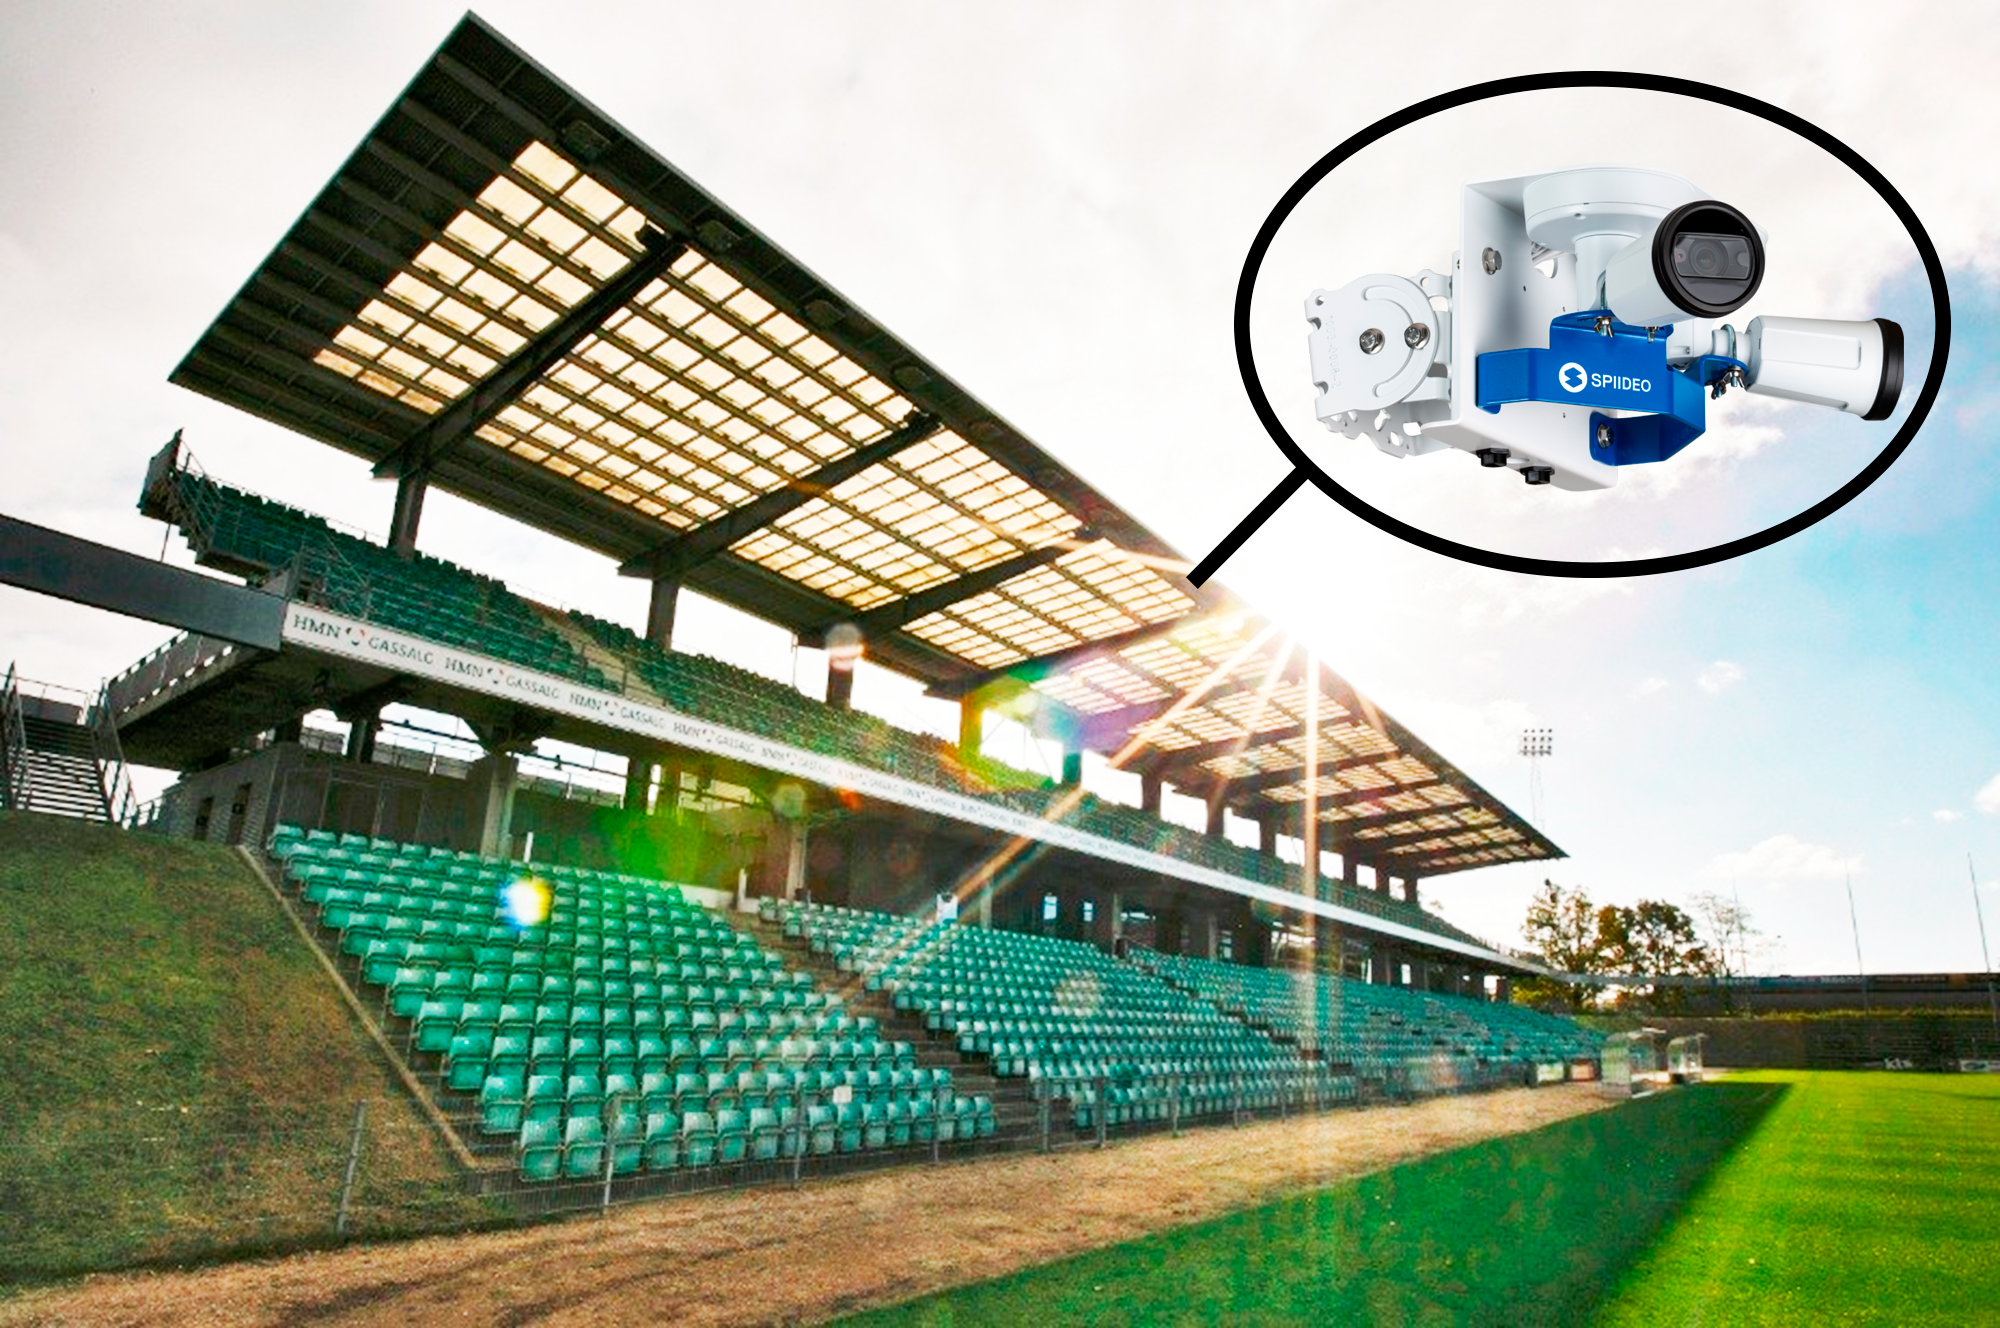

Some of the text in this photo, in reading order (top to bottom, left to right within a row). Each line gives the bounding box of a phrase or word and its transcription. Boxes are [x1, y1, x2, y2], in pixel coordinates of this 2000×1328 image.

[1591, 373, 1652, 393] SPIIDEO
[294, 614, 341, 638] HMN
[446, 657, 484, 677] HMN
[569, 693, 602, 710] HMN
